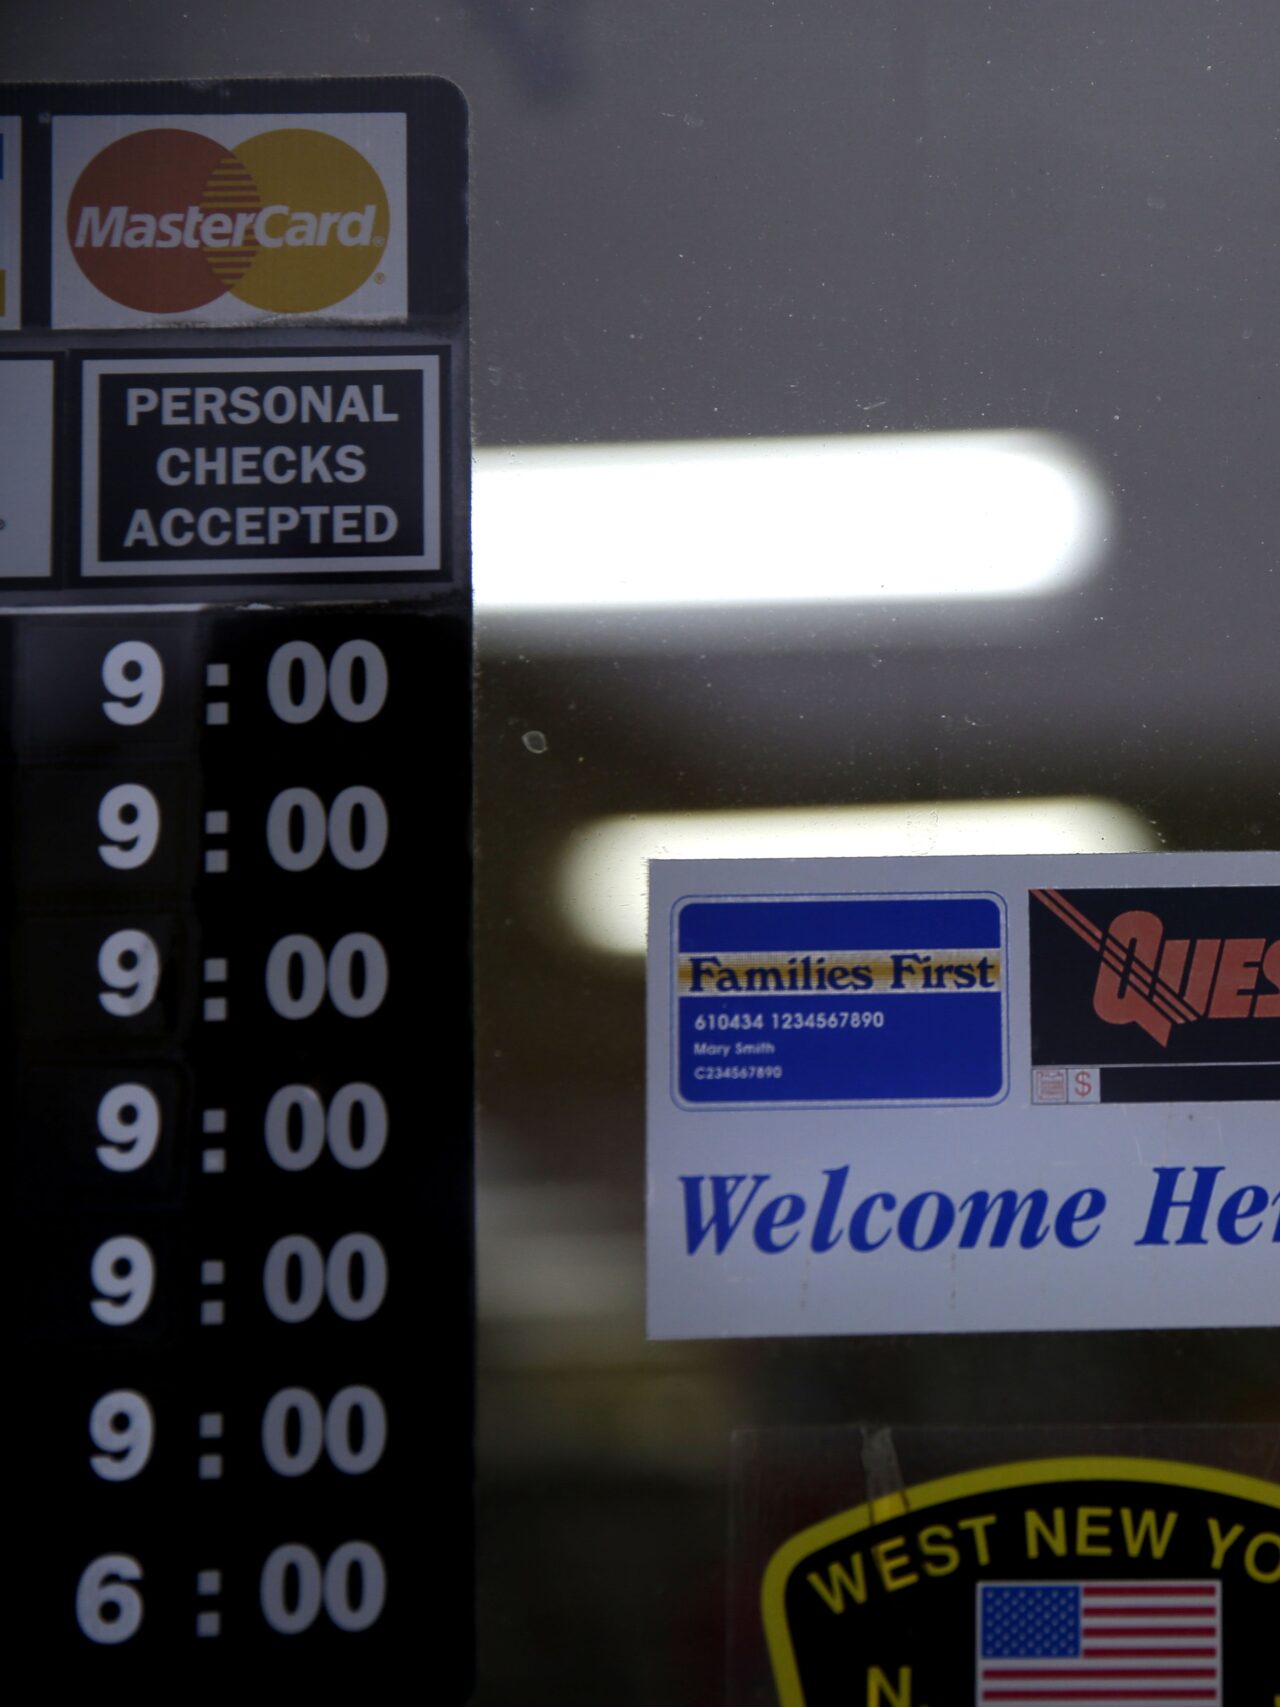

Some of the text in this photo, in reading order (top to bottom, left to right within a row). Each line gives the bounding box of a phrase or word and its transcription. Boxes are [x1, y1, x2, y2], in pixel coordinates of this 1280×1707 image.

[75, 203, 378, 249] MasterCard
[126, 384, 400, 426] PERSONAL
[156, 443, 367, 487] CHECKS
[122, 503, 399, 548] ACCEPTED
[689, 951, 996, 993] Families First
[694, 1010, 885, 1031] 610434 1234567890
[693, 1040, 776, 1058] Mary Smith
[693, 1064, 783, 1080] C234567890
[676, 1164, 1108, 1257] Welcome
[807, 1514, 999, 1616] WEST
[1024, 1507, 1179, 1560] NEW
